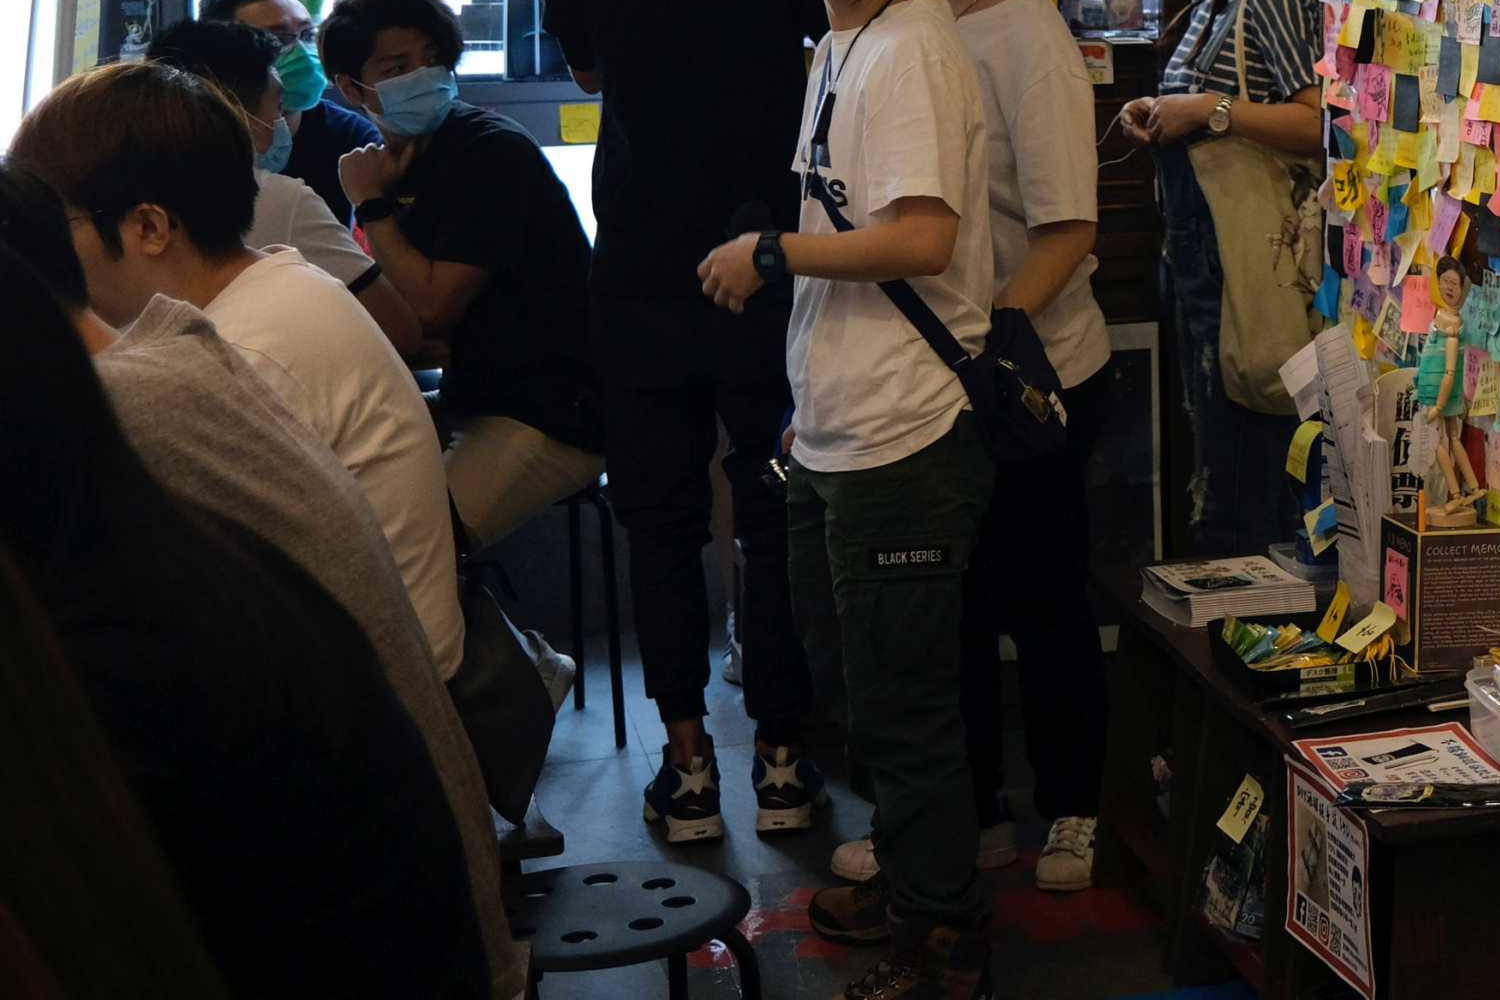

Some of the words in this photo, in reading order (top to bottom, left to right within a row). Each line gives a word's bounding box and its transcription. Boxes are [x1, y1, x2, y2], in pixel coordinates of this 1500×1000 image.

[1426, 544, 1468, 556] COLLECT
[878, 551, 907, 565] BLACK
[910, 550, 942, 563] SERIES
